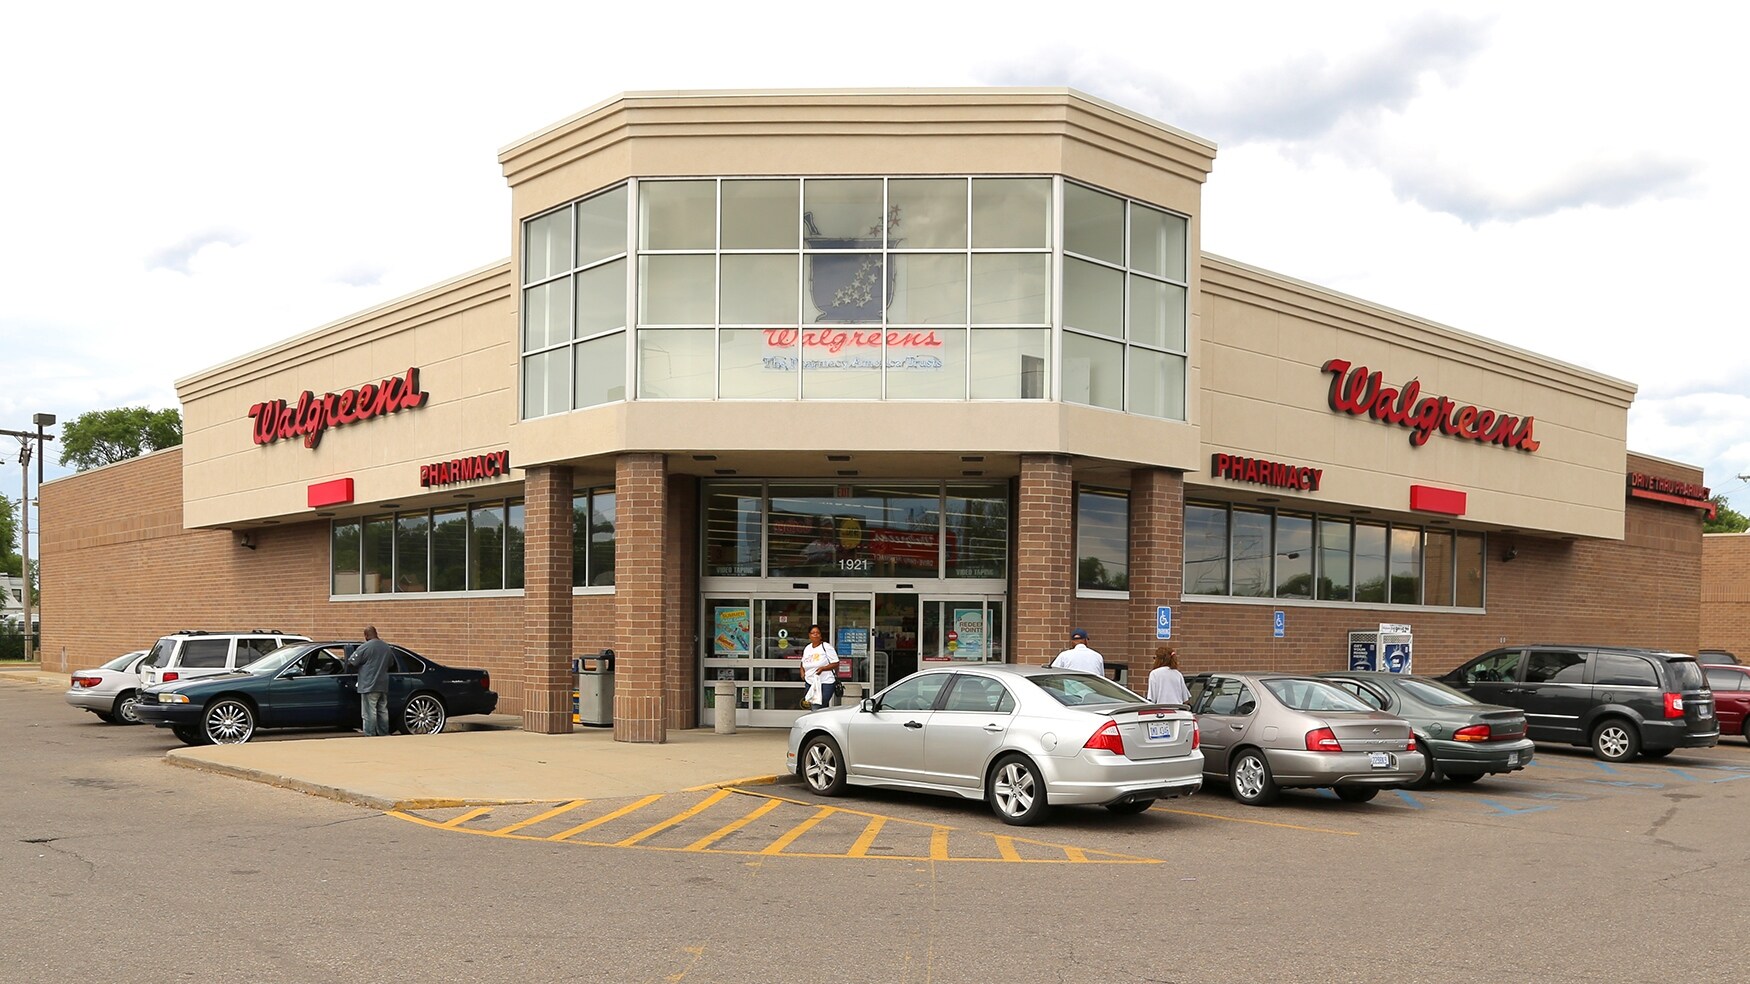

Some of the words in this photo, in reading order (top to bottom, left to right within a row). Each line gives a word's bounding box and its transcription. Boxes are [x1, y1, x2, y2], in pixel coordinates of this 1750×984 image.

[763, 329, 941, 353] Walgreens
[790, 357, 848, 370] Parmacy
[248, 367, 429, 449] Walgreens
[1321, 359, 1540, 452] Walgreens
[420, 450, 510, 487] PHARMACY
[1211, 453, 1322, 491] PHARMACY
[1631, 472, 1654, 489] DRIVE
[1655, 478, 1674, 493] THRU
[839, 559, 867, 570] 1921
[955, 568, 972, 576] VIDEO
[974, 568, 994, 576] TAPING
